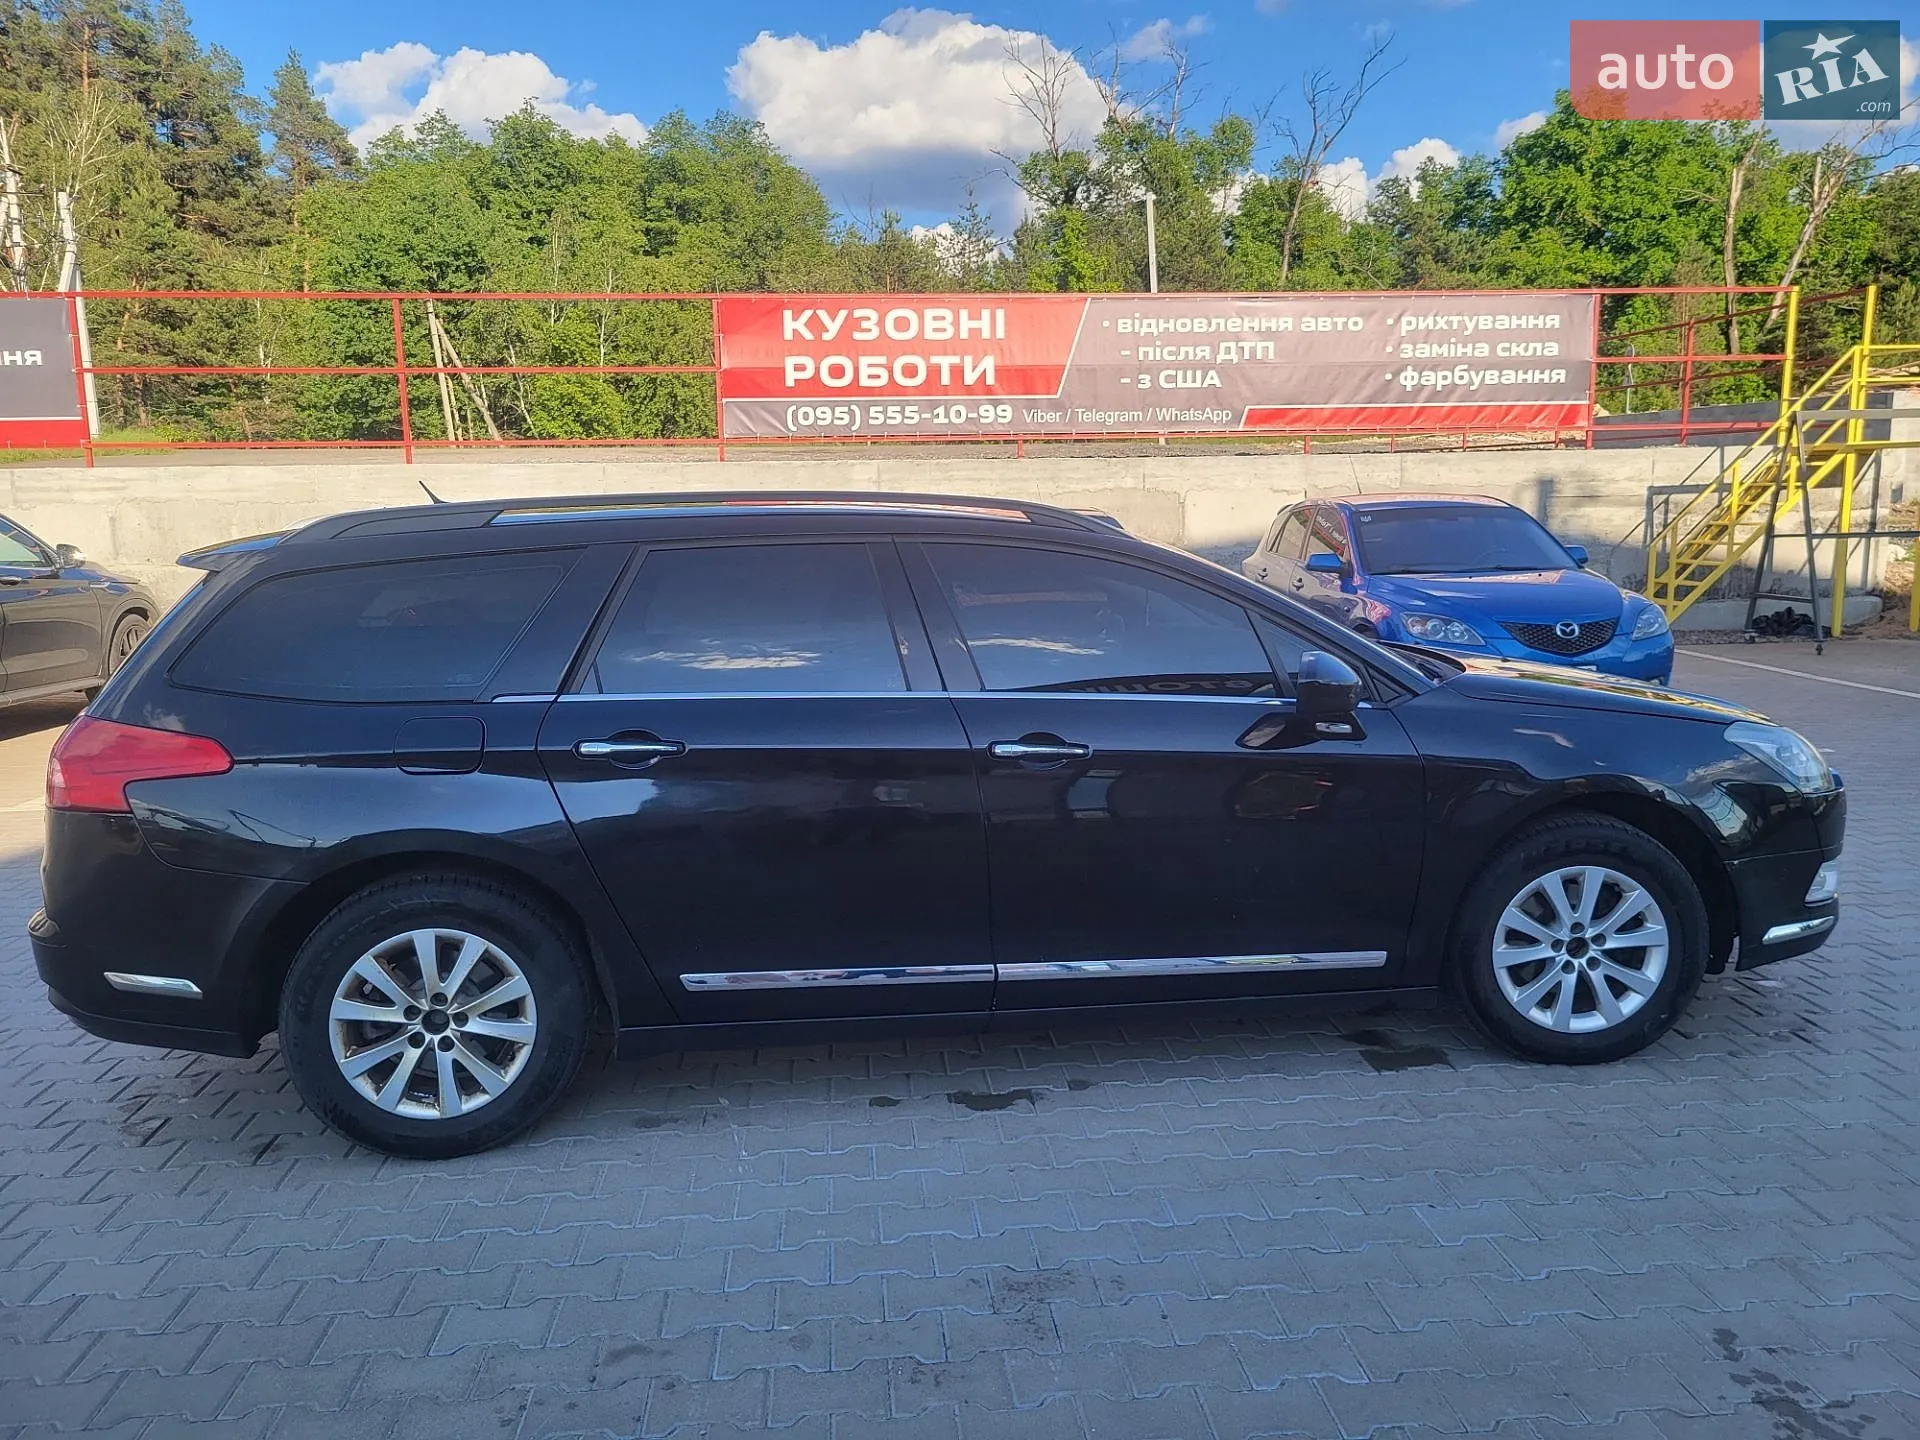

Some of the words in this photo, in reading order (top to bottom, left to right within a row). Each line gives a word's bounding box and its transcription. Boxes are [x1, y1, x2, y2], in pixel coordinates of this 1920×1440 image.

[782, 308, 1005, 341] КУЗОВНІ
[1117, 312, 1293, 337] відновлення
[1300, 316, 1364, 332] авто
[1400, 312, 1561, 336] рихтування
[0, 350, 43, 366] ня
[1138, 340, 1211, 361] після
[1216, 341, 1275, 364] ДТП
[1399, 337, 1490, 359] заміна
[1496, 342, 1559, 357] скла
[784, 355, 995, 388] РОБОТИ
[1137, 374, 1152, 389] з
[1158, 369, 1223, 389] США
[1399, 364, 1567, 391] фарбування
[786, 404, 861, 432] (095)
[868, 404, 1013, 425] 555-10-99
[1022, 408, 1063, 424] Viber
[1075, 408, 1142, 426] Telegram
[1156, 407, 1233, 425] WhatsApp
